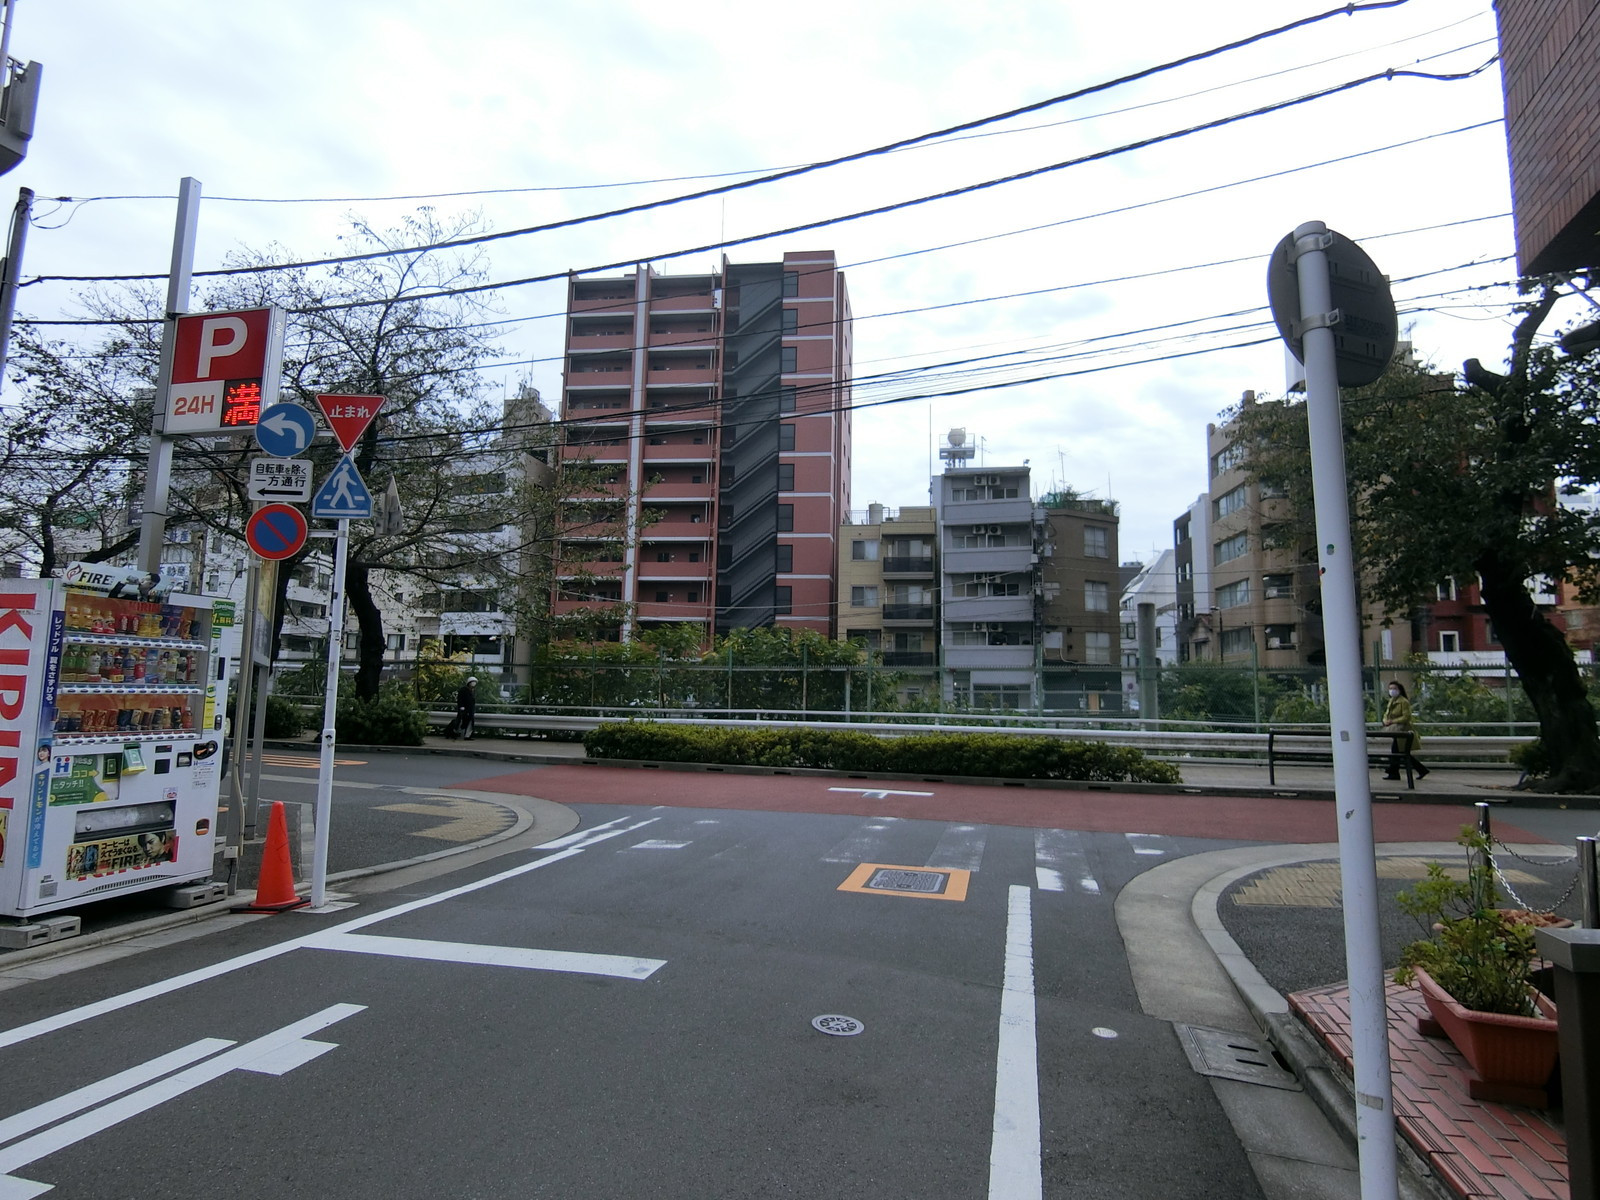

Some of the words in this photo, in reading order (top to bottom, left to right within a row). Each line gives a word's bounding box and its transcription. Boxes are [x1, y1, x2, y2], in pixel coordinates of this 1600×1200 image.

[196, 316, 248, 378] P
[174, 395, 215, 416] 24H
[224, 382, 261, 425] 満
[329, 404, 371, 418] 止まれ
[255, 463, 307, 475] 自転車を除く
[255, 475, 307, 488] 一方通行
[78, 571, 113, 585] FIRE
[0, 593, 37, 810] KIRIN
[101, 839, 130, 850] コーヒーは
[111, 853, 142, 869] FIRE
